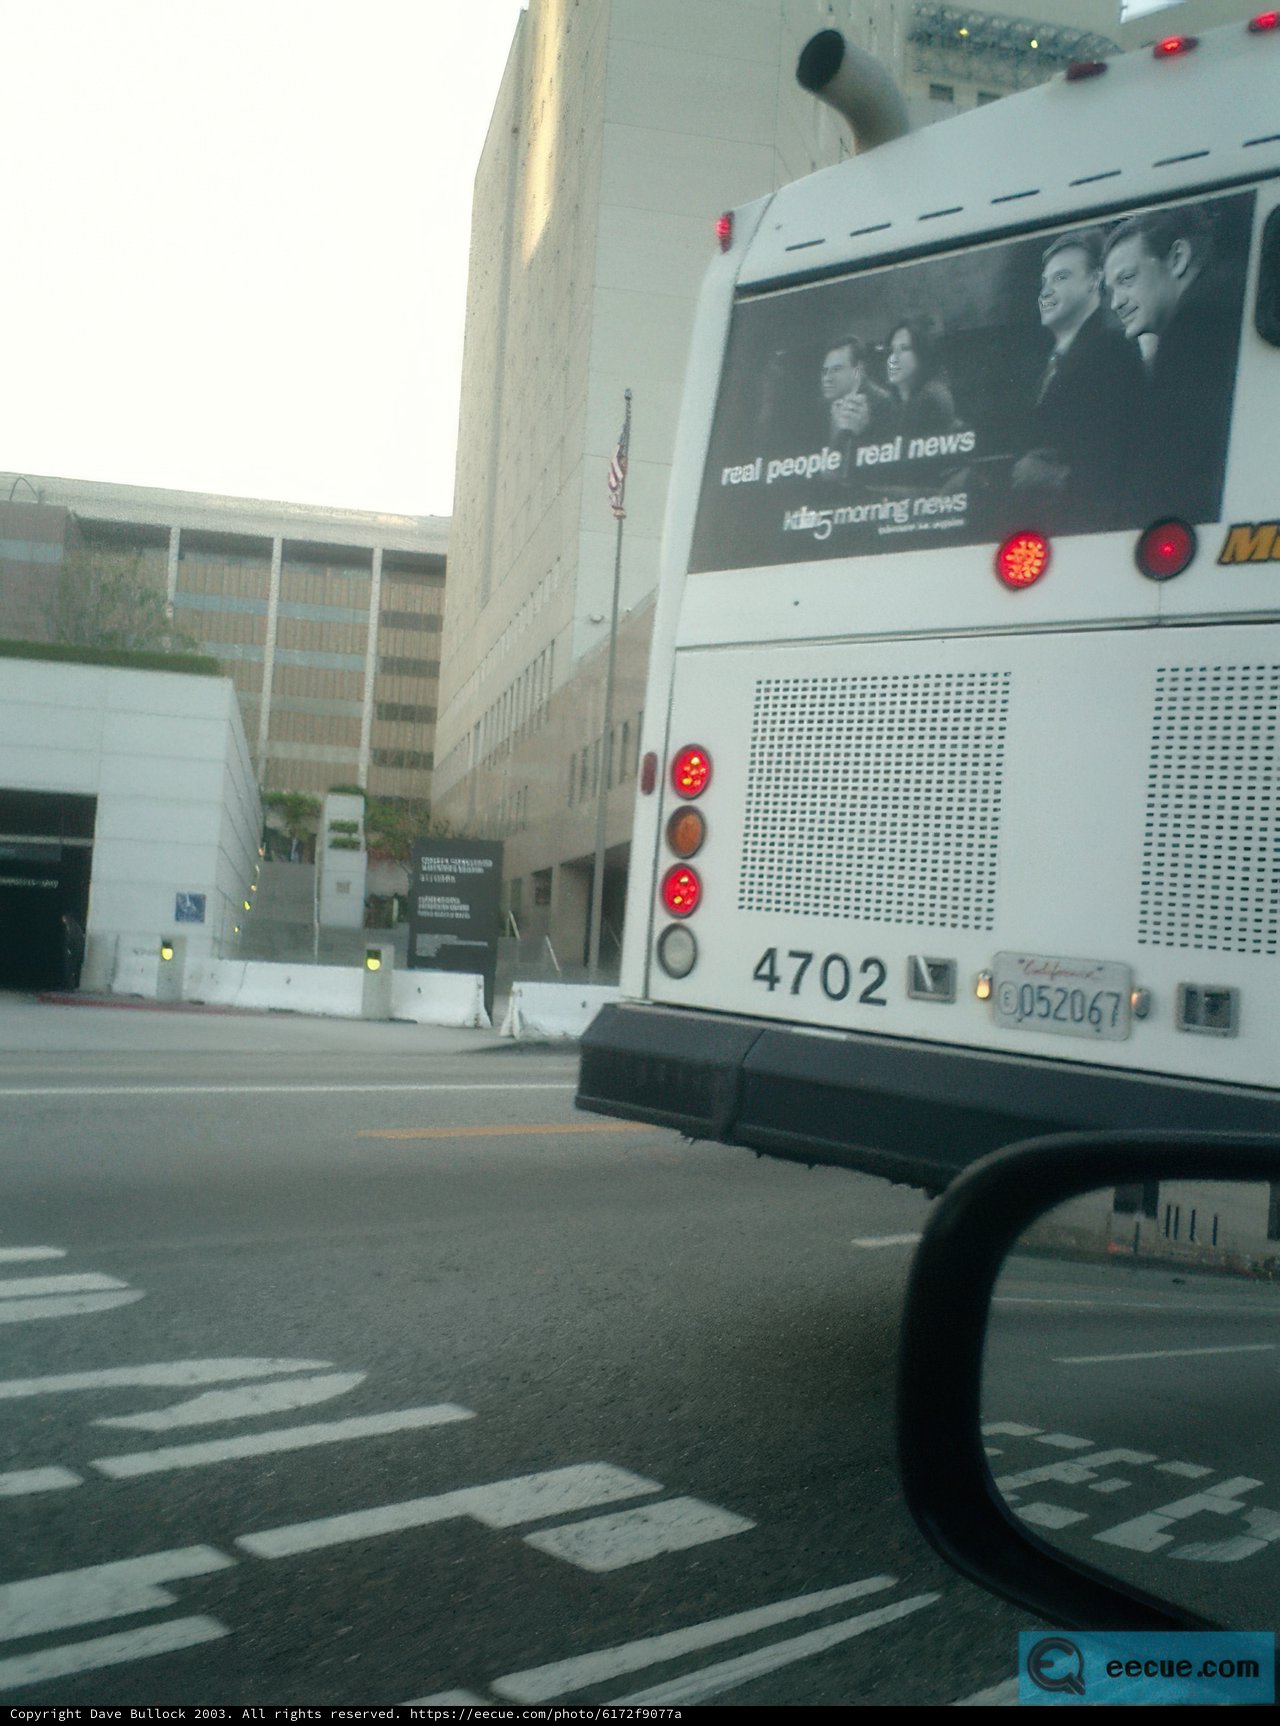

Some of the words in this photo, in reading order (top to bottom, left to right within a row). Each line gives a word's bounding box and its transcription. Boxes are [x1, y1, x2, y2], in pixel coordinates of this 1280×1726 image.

[721, 457, 763, 486] real
[765, 446, 842, 484] people
[856, 435, 903, 467] real
[908, 430, 976, 460] news
[834, 497, 910, 523] morning
[913, 492, 967, 516] news
[753, 947, 888, 1006] 4702
